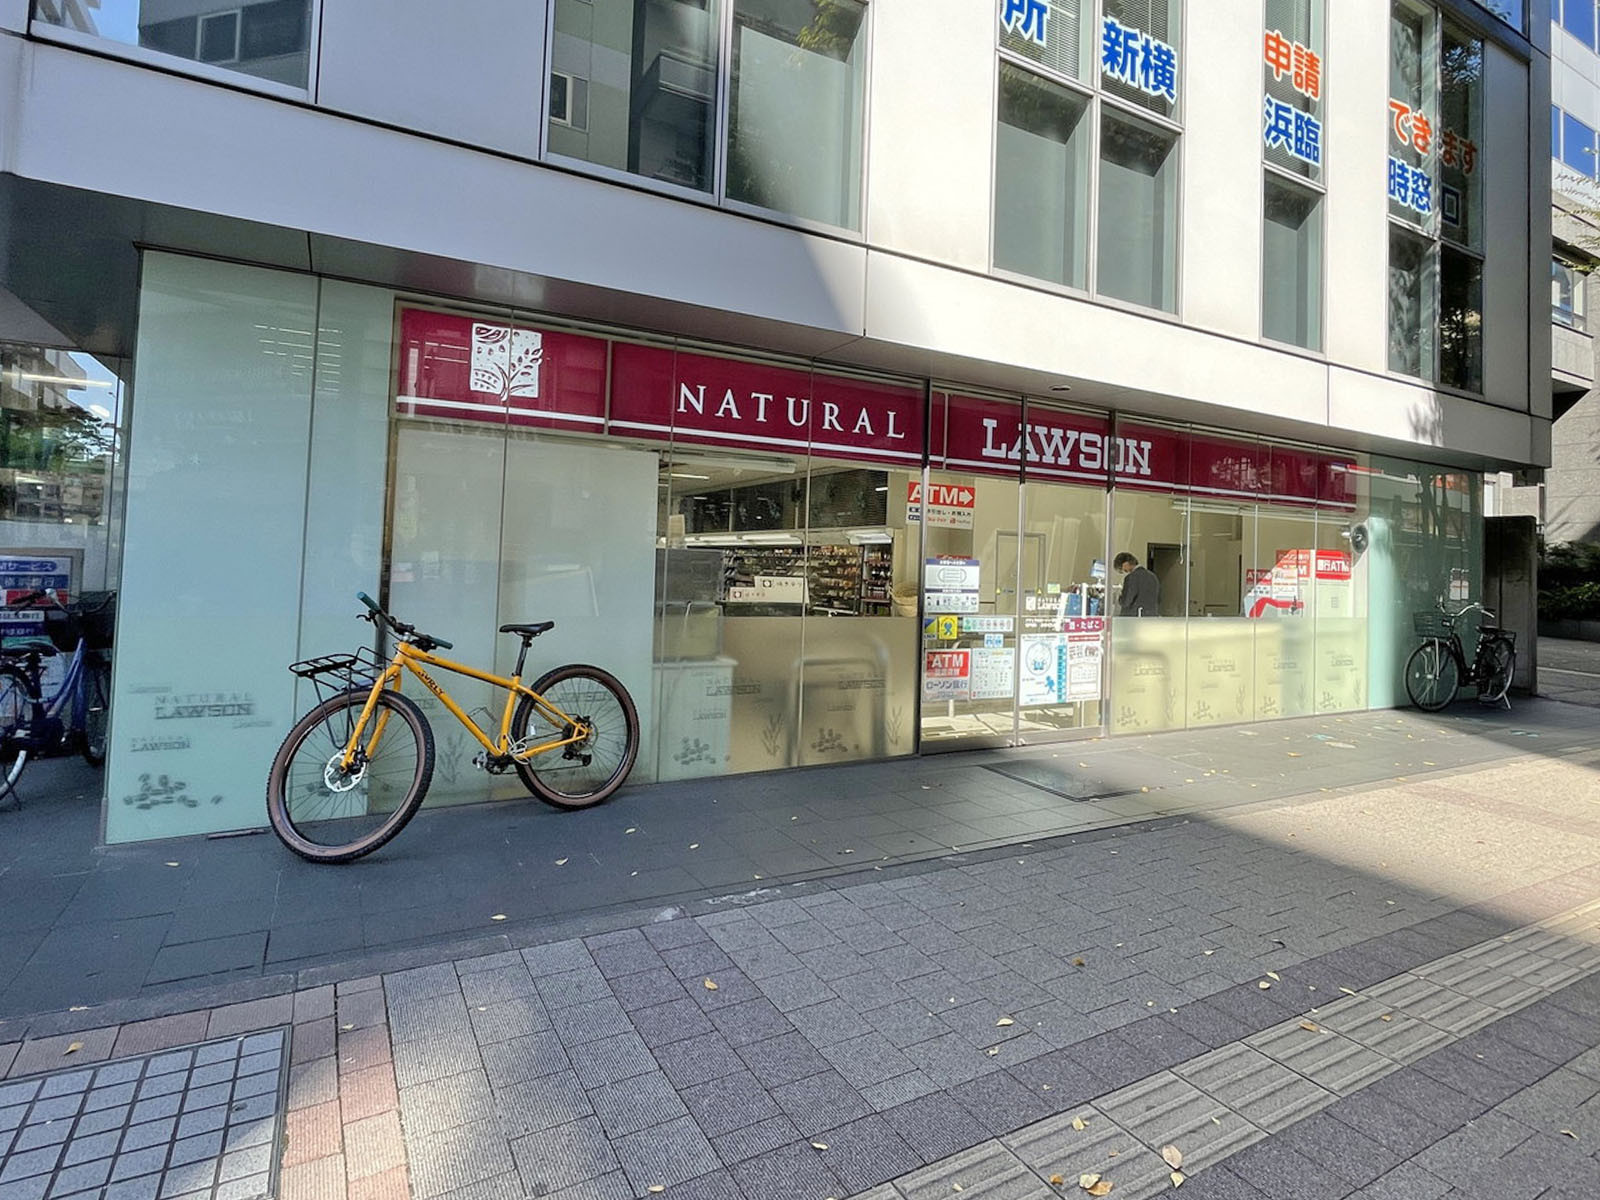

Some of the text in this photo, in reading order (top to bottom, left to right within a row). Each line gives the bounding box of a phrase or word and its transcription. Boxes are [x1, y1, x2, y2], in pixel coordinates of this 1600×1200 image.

[1263, 31, 1321, 98] 申請
[1101, 16, 1177, 103] 新横
[1264, 95, 1320, 165] 浜臨
[677, 382, 1152, 475] NATURAL LAWSON
[909, 484, 958, 505] ATM
[931, 654, 963, 668] ATM
[154, 703, 256, 719] LAWSON
